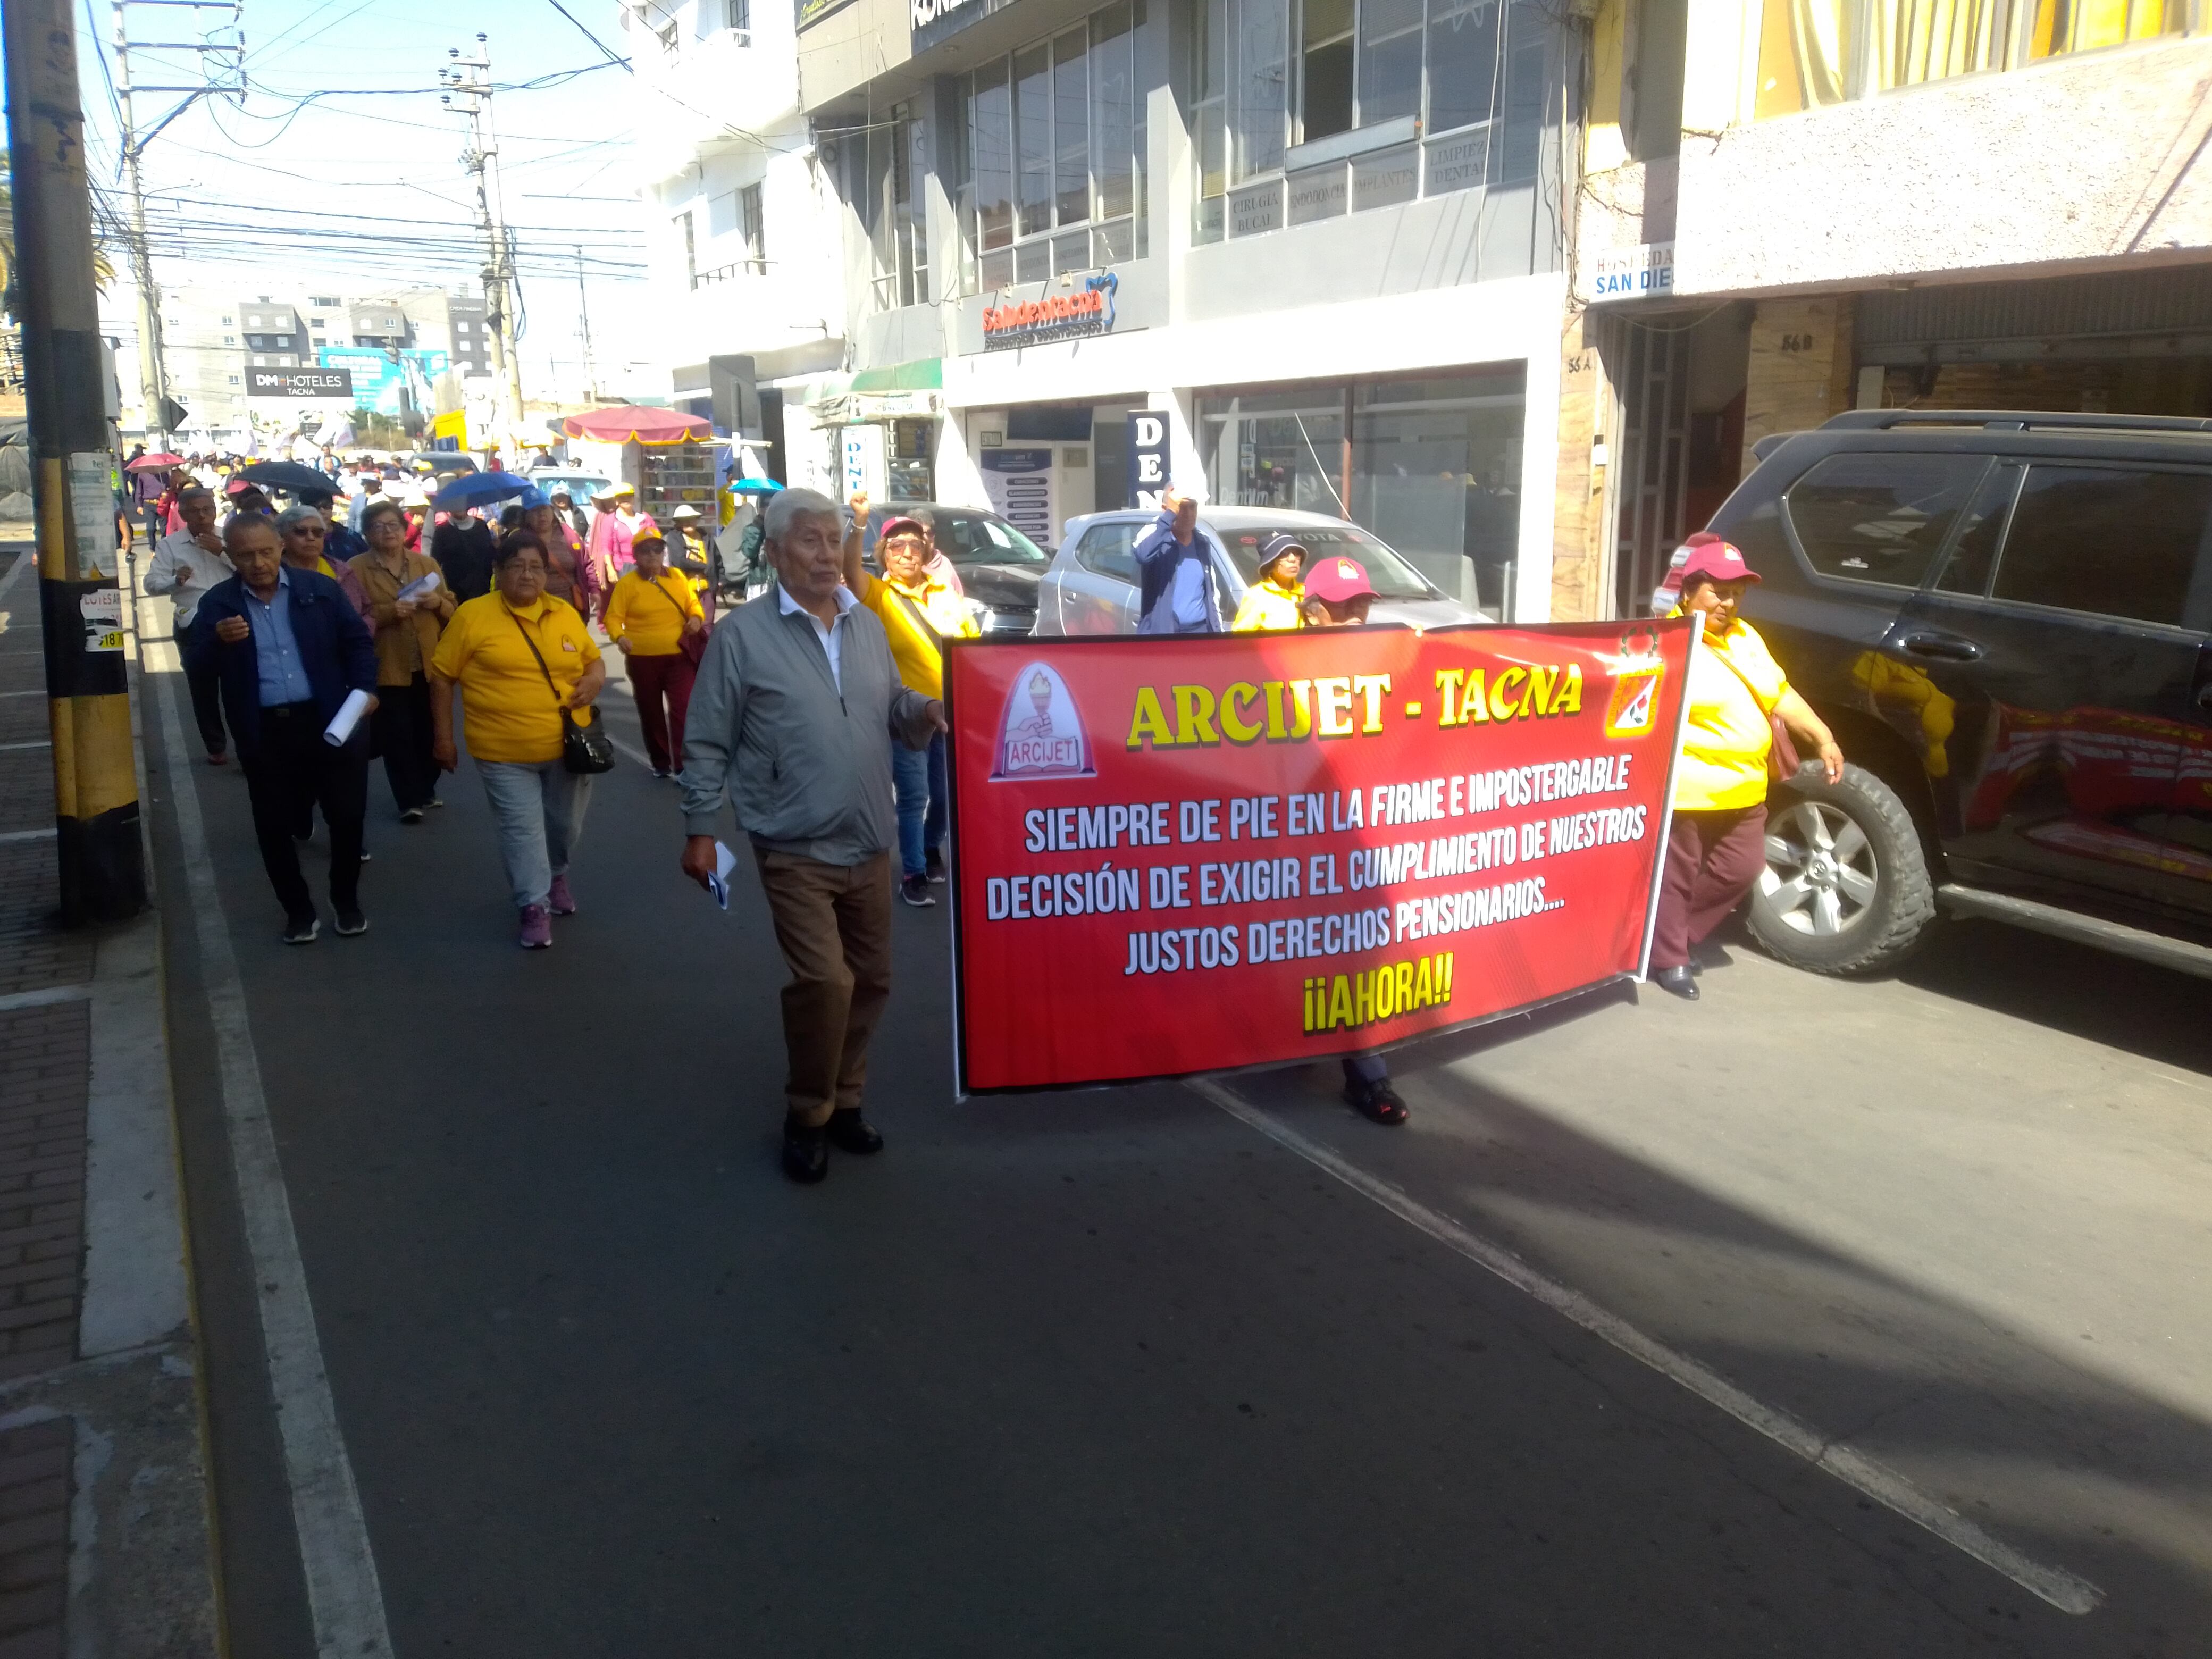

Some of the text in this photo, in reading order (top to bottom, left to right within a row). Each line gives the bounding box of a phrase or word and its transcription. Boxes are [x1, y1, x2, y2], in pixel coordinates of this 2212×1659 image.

[911, 0, 963, 31] KON
[1430, 139, 1494, 166] LIMPIEZ
[1354, 167, 1417, 194] IMPLANTES
[1435, 161, 1485, 184] DENTAL
[1234, 191, 1278, 213] CIRUGÍA
[1290, 182, 1346, 209] ENDODONCIA
[1238, 213, 1272, 232] BUCAL
[1596, 267, 1674, 294] SAN DIE
[983, 290, 1102, 331] Saludentacna
[287, 375, 342, 387] HOTELES
[1294, 533, 1342, 542] YOTA
[1126, 671, 1392, 750] ARCIJET
[1435, 662, 1584, 728] TACNA
[1010, 740, 1073, 764] ARCIJET
[1024, 752, 1632, 853] SIEMPRE DE PIE EN LA FIRME E IMPOSTERGABLE
[987, 802, 1647, 920] DECISIÓN DE EXIGIR EL CUMPLIMIENTO DE NUESTROS
[1123, 923, 1240, 976] JUSTOS
[1247, 906, 1390, 965] DERECHOS
[1303, 951, 1454, 1035] ¡¡AHORA!!
